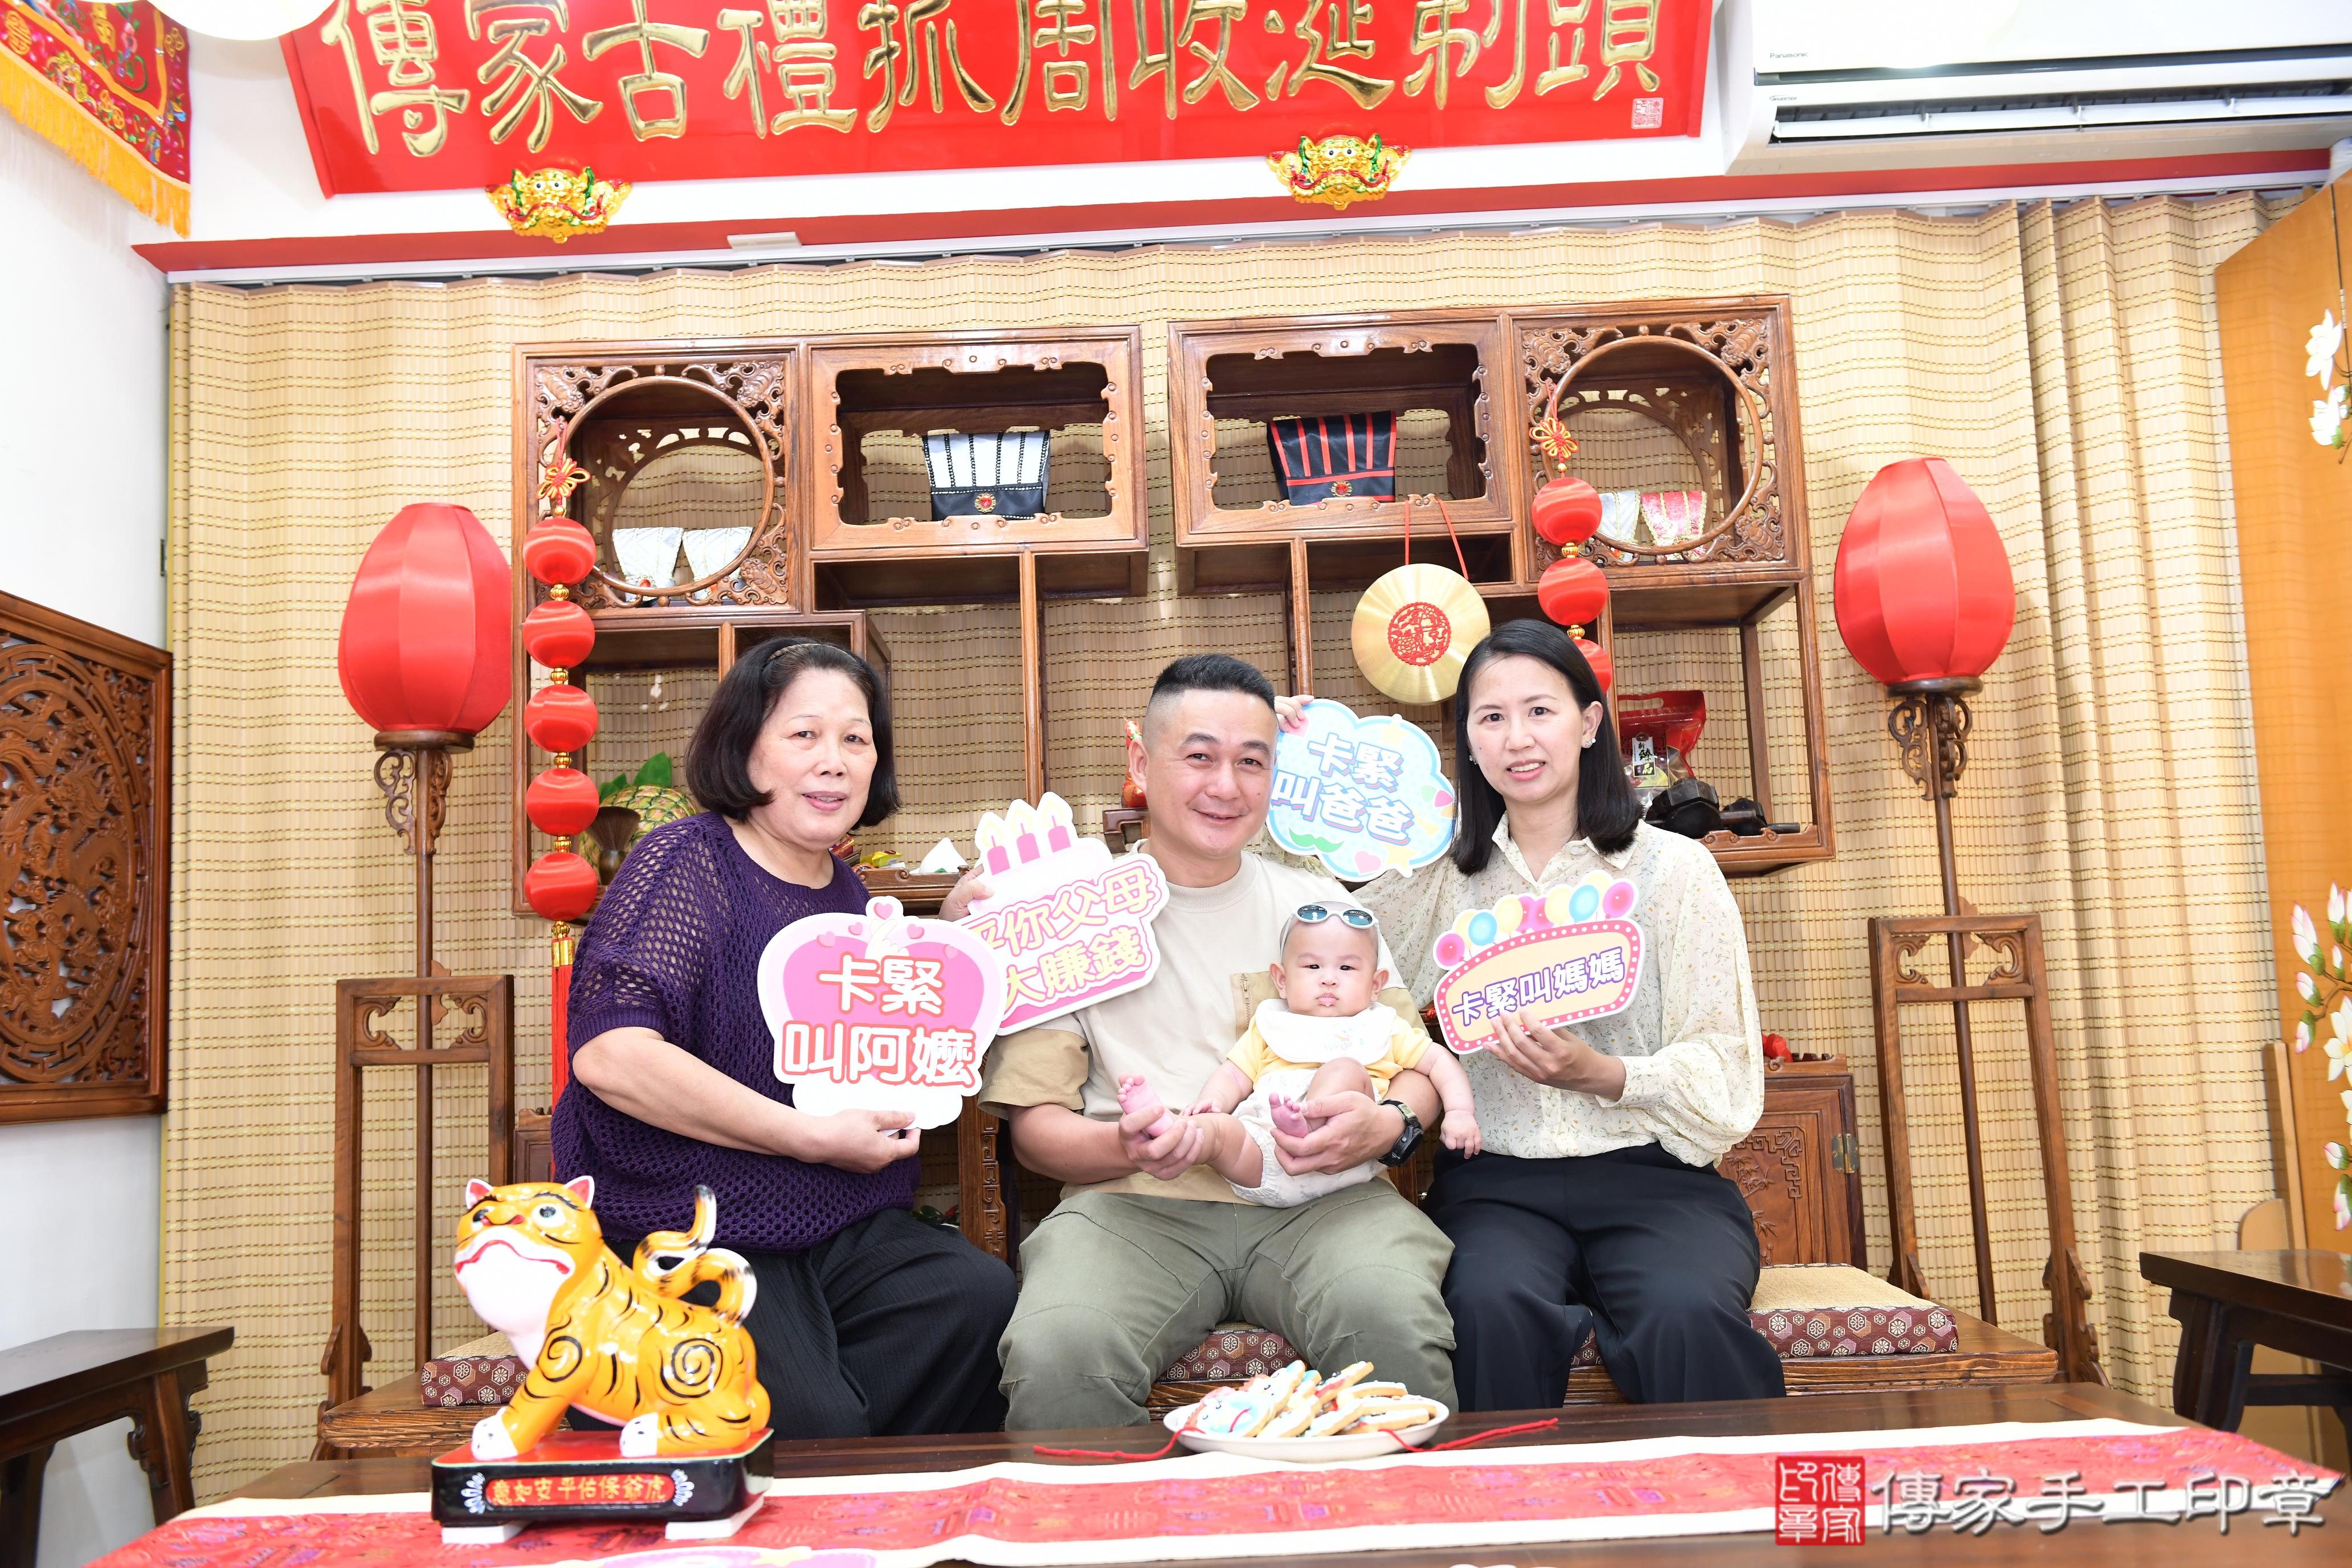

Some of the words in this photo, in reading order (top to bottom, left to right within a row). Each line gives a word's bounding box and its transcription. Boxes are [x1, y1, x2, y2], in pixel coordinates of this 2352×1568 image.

[1308, 732, 1404, 793] 卡緊
[1271, 770, 1415, 846] 叫爸爸
[818, 952, 945, 1016] 卡緊
[1004, 925, 1145, 1013] 大賺錢
[1452, 946, 1625, 1027] 卡緊叫媽媽
[782, 1022, 977, 1088] 叫阿嬤
